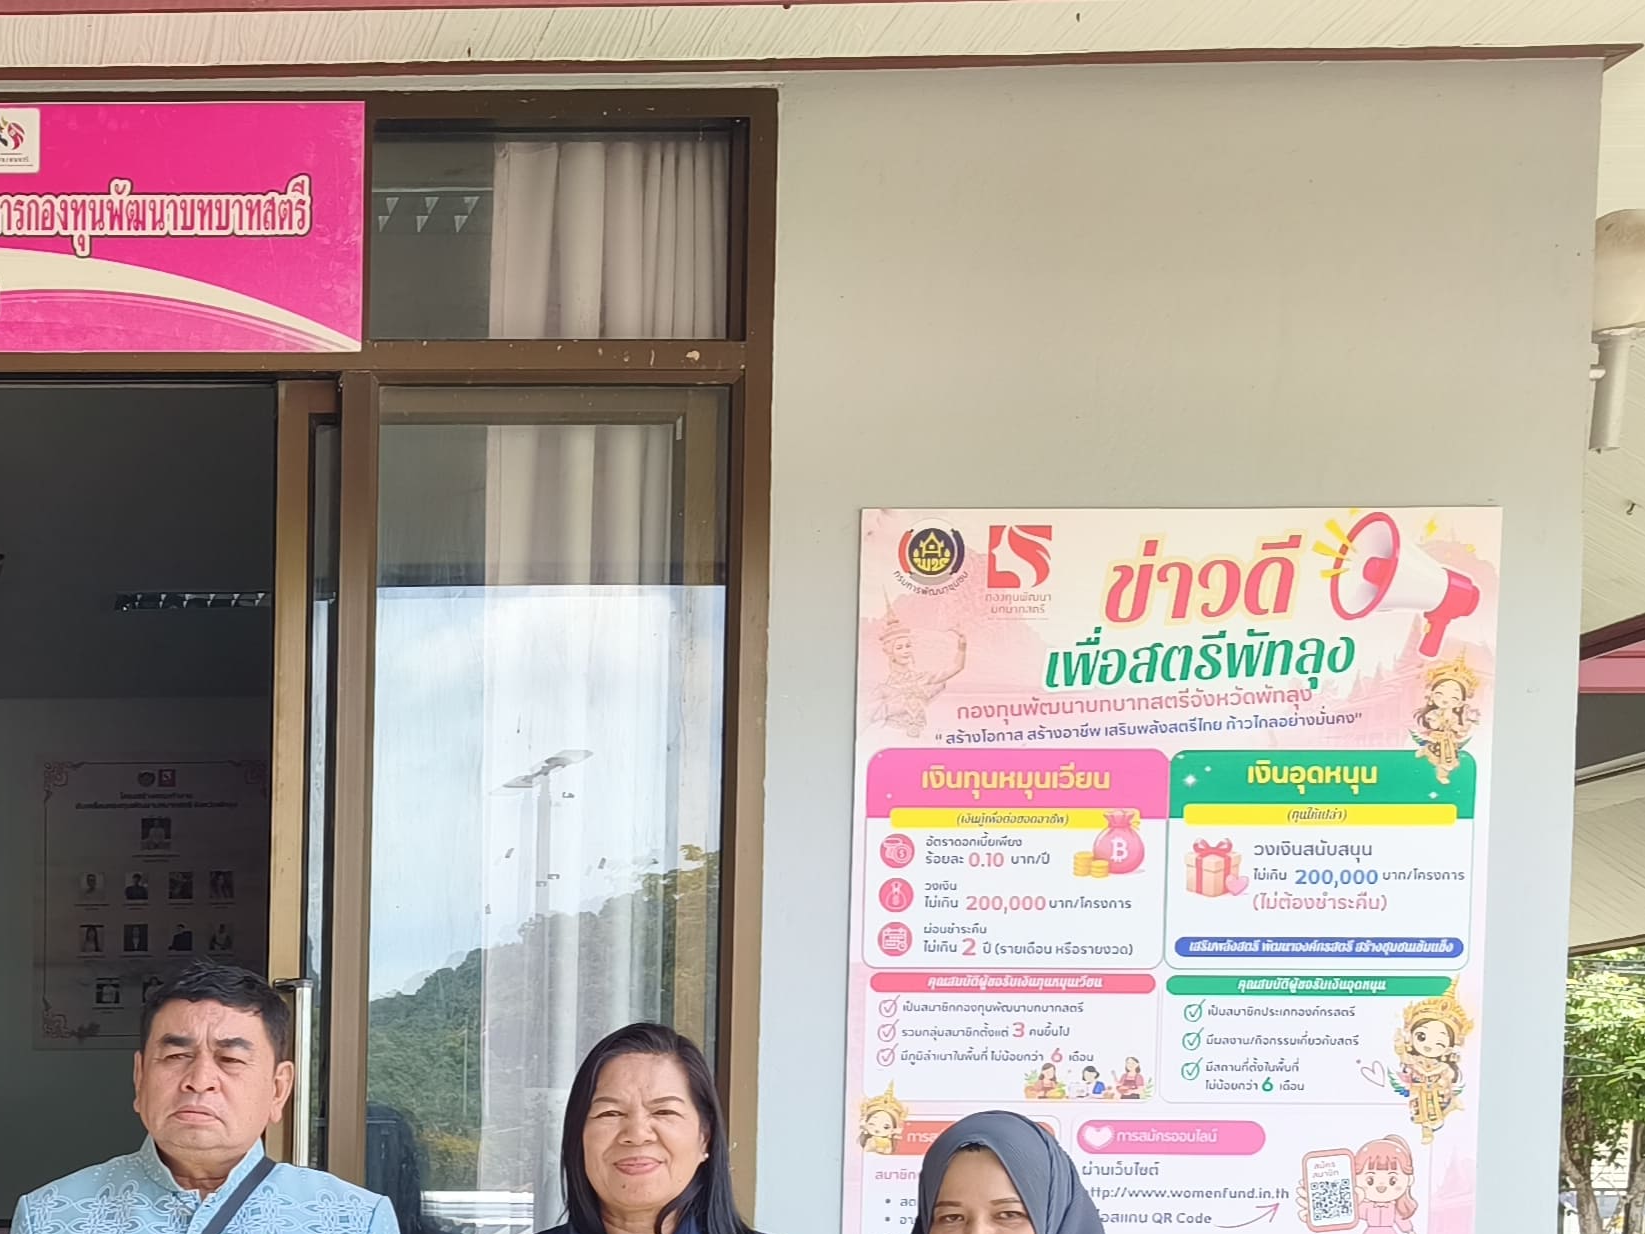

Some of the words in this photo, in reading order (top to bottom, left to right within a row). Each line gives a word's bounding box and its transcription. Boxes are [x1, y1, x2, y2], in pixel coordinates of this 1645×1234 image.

[1106, 533, 1303, 624] ข่าวดี
[985, 592, 1052, 605] กองทุนพัฒนา
[1045, 627, 1354, 690] เพื่อสตรีพัทลุง
[957, 684, 1313, 725] กองทุนพัฒนาบทบาทสตรีจังหวัดพัทลุง
[946, 728, 1024, 745] สร้างโอกาส
[1027, 723, 1101, 741] สร้างอาชีพ
[1104, 716, 1223, 737] เสริมพลังสตรีไทย
[921, 763, 1111, 800] เงินทุนหมุนเวียน
[1247, 760, 1378, 795] เงินอุดหนุน
[1287, 806, 1348, 823] (ทุนให้เปล่า)
[925, 832, 1023, 848] อัตราดอกเบี้ยเพียง
[925, 851, 965, 865] ร้อยละ
[968, 852, 1004, 868] 0.10
[1011, 850, 1050, 866] บาท/ปี
[1254, 840, 1373, 864] วงเงินสนับสนุน
[924, 880, 957, 892] วงเงิน
[1254, 867, 1287, 881] ไม่เกิน
[1295, 869, 1378, 888] 200,000
[1382, 868, 1466, 882] บาท/โครงการ
[924, 895, 959, 909] ไม่เกิน
[966, 896, 1046, 914] 200,000
[1049, 897, 1132, 910] บาท/โครงการ
[1252, 892, 1388, 912] (ไม่ต้องชำระคืน)
[923, 922, 987, 934] ผ่อนชำระคืน
[923, 939, 957, 953] ไม่เกิน
[962, 938, 977, 956] 2
[983, 940, 992, 954] ปี
[995, 942, 1052, 956] (รายเดือน
[1055, 941, 1134, 956] หรือรายงวด)
[903, 1001, 1084, 1016] เป็นสมาชิกกองทุนพัฒนาบทบาทสตรี
[1208, 1004, 1356, 1018] เป็นสมาชิกประเภทองค์กรสตรี
[901, 1023, 1009, 1041] รวมกลุ่มสมาชิกตั้งแต่
[1012, 1022, 1025, 1038] 3
[1028, 1022, 1070, 1037] คนขึ้นไป
[1206, 1031, 1359, 1046] มีผลงาน/กิจกรรมเกี่ยวกับสตรี
[990, 1048, 1044, 1063] ไม่น้อยกว่า
[1051, 1048, 1063, 1063] 6
[1068, 1050, 1094, 1062] เดือน
[1206, 1057, 1299, 1073] มีสถานที่ตั้งในพื้นที่
[1206, 1079, 1258, 1092] ไม่น้อยกว่า
[1262, 1077, 1273, 1092] 6
[1280, 1080, 1305, 1092] เดือน
[1117, 1128, 1218, 1144] การสมัครออนไลน์
[875, 1169, 919, 1180] สมาชิก
[1082, 1160, 1160, 1177] ผ่านเว็บไซต์
[1088, 1186, 1290, 1200] ttp://www.womenfund.in.th
[1152, 1211, 1173, 1224] QR
[1176, 1212, 1212, 1224] Code
